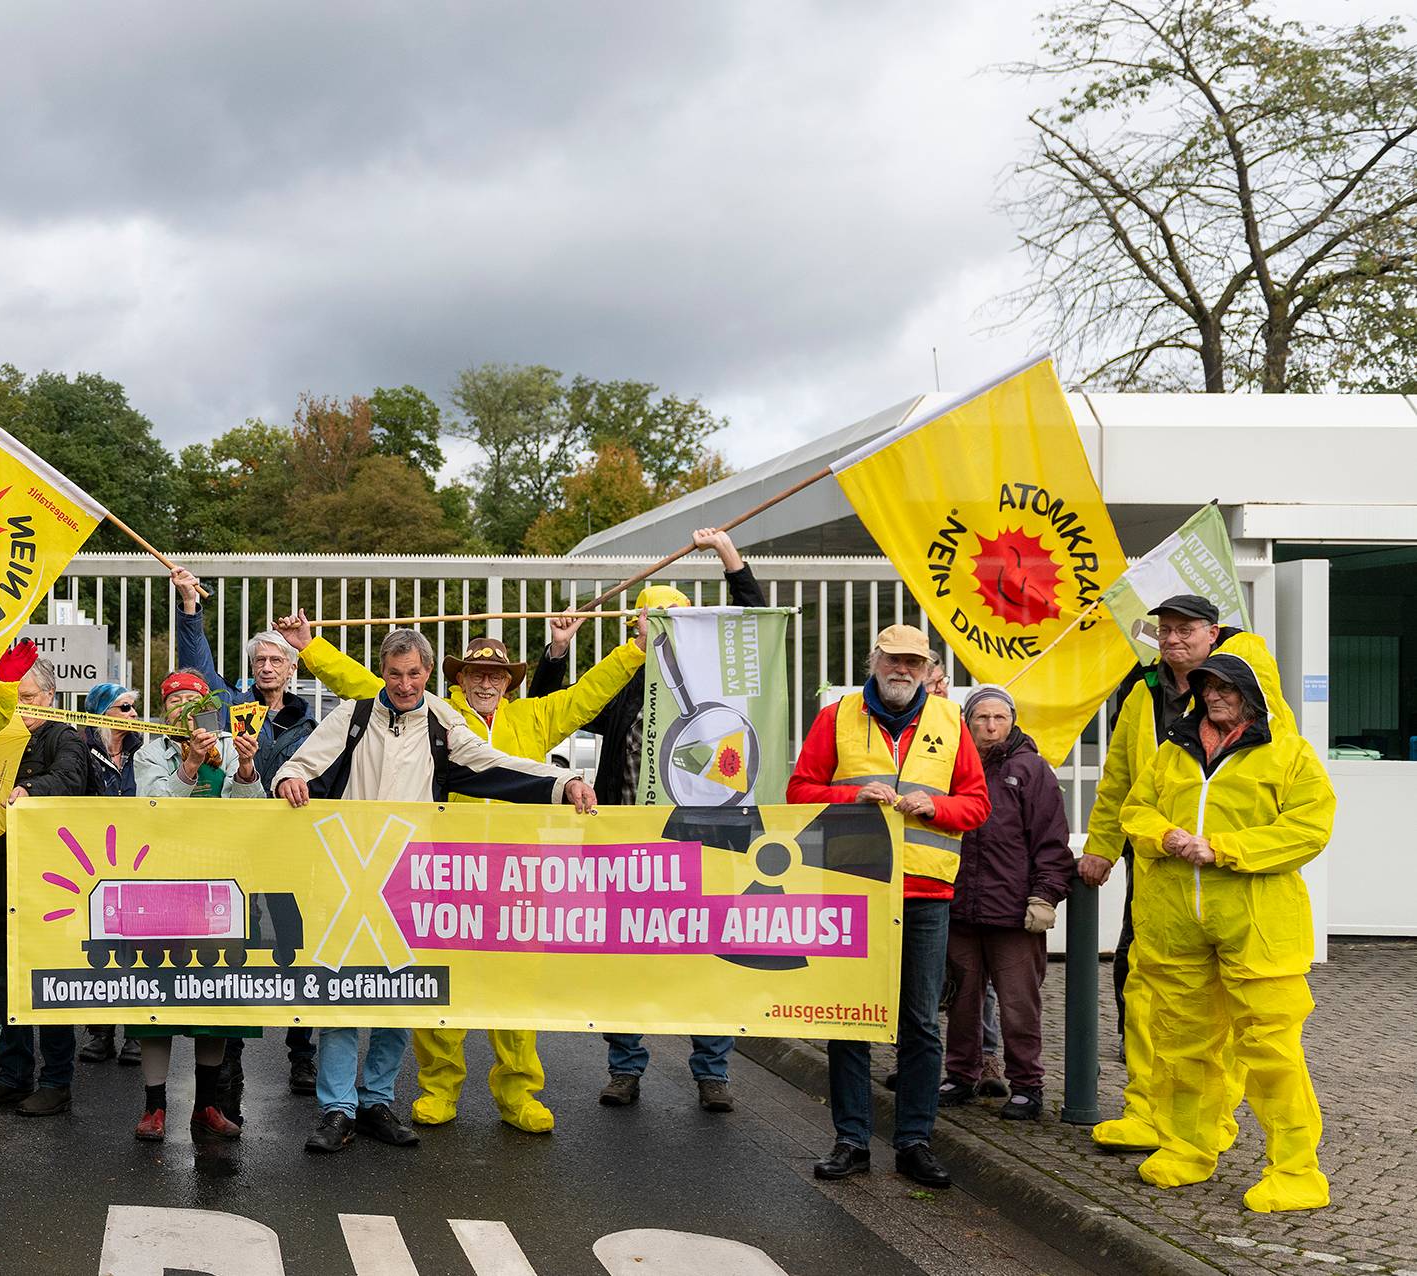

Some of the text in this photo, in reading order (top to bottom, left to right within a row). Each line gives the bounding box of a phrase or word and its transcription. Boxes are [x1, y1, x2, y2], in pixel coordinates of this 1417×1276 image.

[928, 515, 1042, 661] NEIN DANKE
[1180, 557, 1211, 593] Rosen
[724, 620, 736, 665] Rosen
[53, 664, 97, 679] UNG
[409, 848, 686, 893] KEIN ATOMMÜLL
[410, 900, 853, 946] VON JÜLICH NACH AHAUS!
[42, 973, 438, 1003] Konzeptlos, überflüssig & gefährlich
[765, 1003, 888, 1023] .ausgestrahlt
